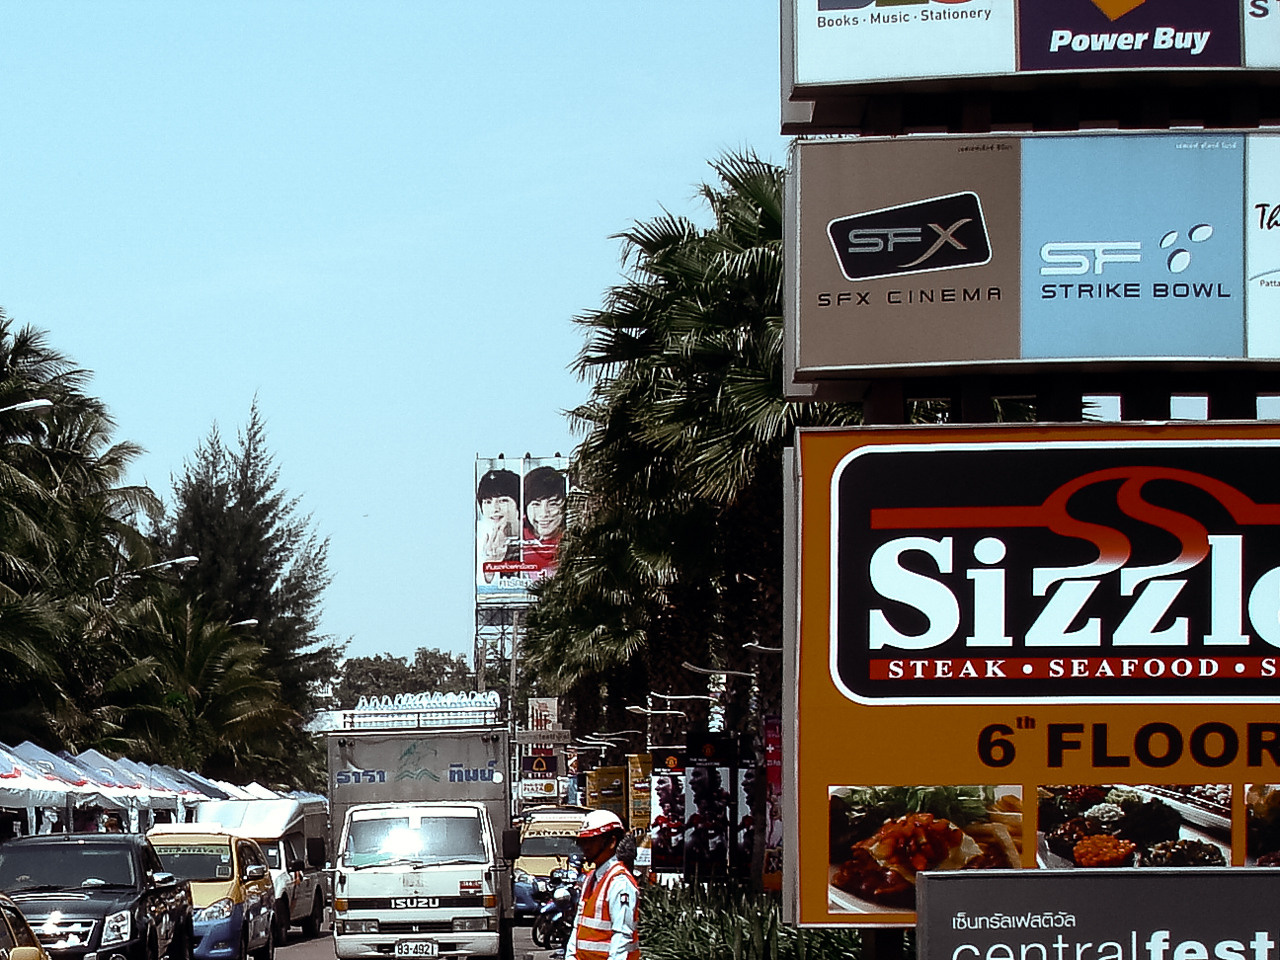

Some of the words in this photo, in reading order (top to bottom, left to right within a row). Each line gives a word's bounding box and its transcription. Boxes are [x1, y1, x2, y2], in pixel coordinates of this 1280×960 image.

[817, 14, 859, 28] Books
[869, 12, 909, 25] Music
[920, 8, 991, 22] Stationery
[1049, 29, 1148, 53] Power
[1153, 27, 1211, 55] Buy
[847, 217, 973, 268] SFX
[1039, 240, 1141, 277] SF
[817, 291, 871, 307] SFX
[887, 287, 1002, 305] CINEMA
[1041, 282, 1141, 299] STRIKE
[1153, 282, 1231, 298] BOWL
[888, 659, 1008, 679] STEAK
[1049, 658, 1219, 678] SEAFOOD
[336, 769, 386, 784] ธารา
[390, 898, 440, 909] ISUZU
[952, 911, 1076, 929] เซ็นทรัลเฟสติวัล
[397, 943, 434, 956] 83-4921
